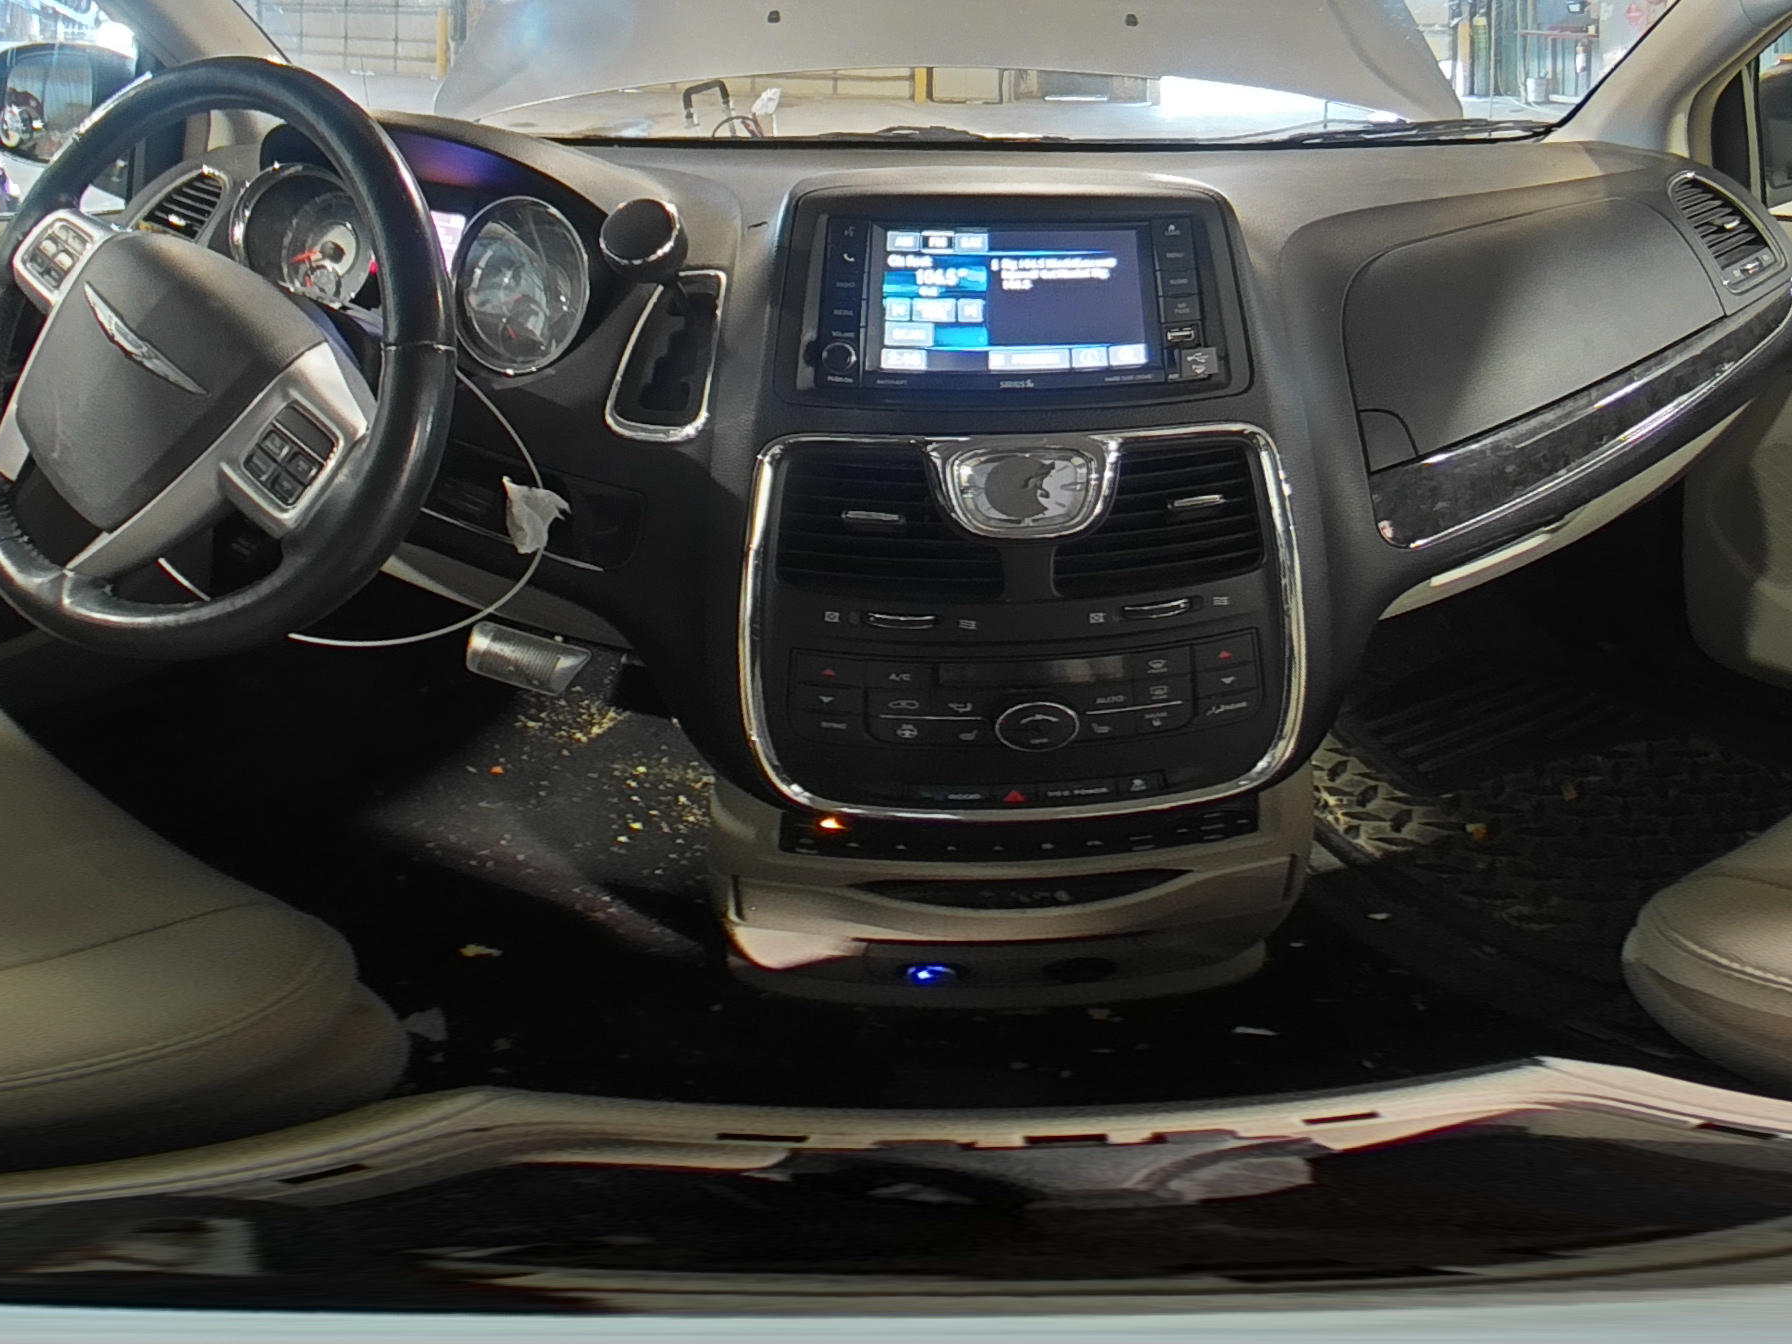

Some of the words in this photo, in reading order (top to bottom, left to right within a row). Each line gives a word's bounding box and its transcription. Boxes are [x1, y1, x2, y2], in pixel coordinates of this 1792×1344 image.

[895, 235, 914, 247] AM
[929, 235, 948, 248] FM
[915, 268, 958, 286] 106.5
[889, 672, 911, 681] A/C
[1095, 695, 1125, 704] AUTO
